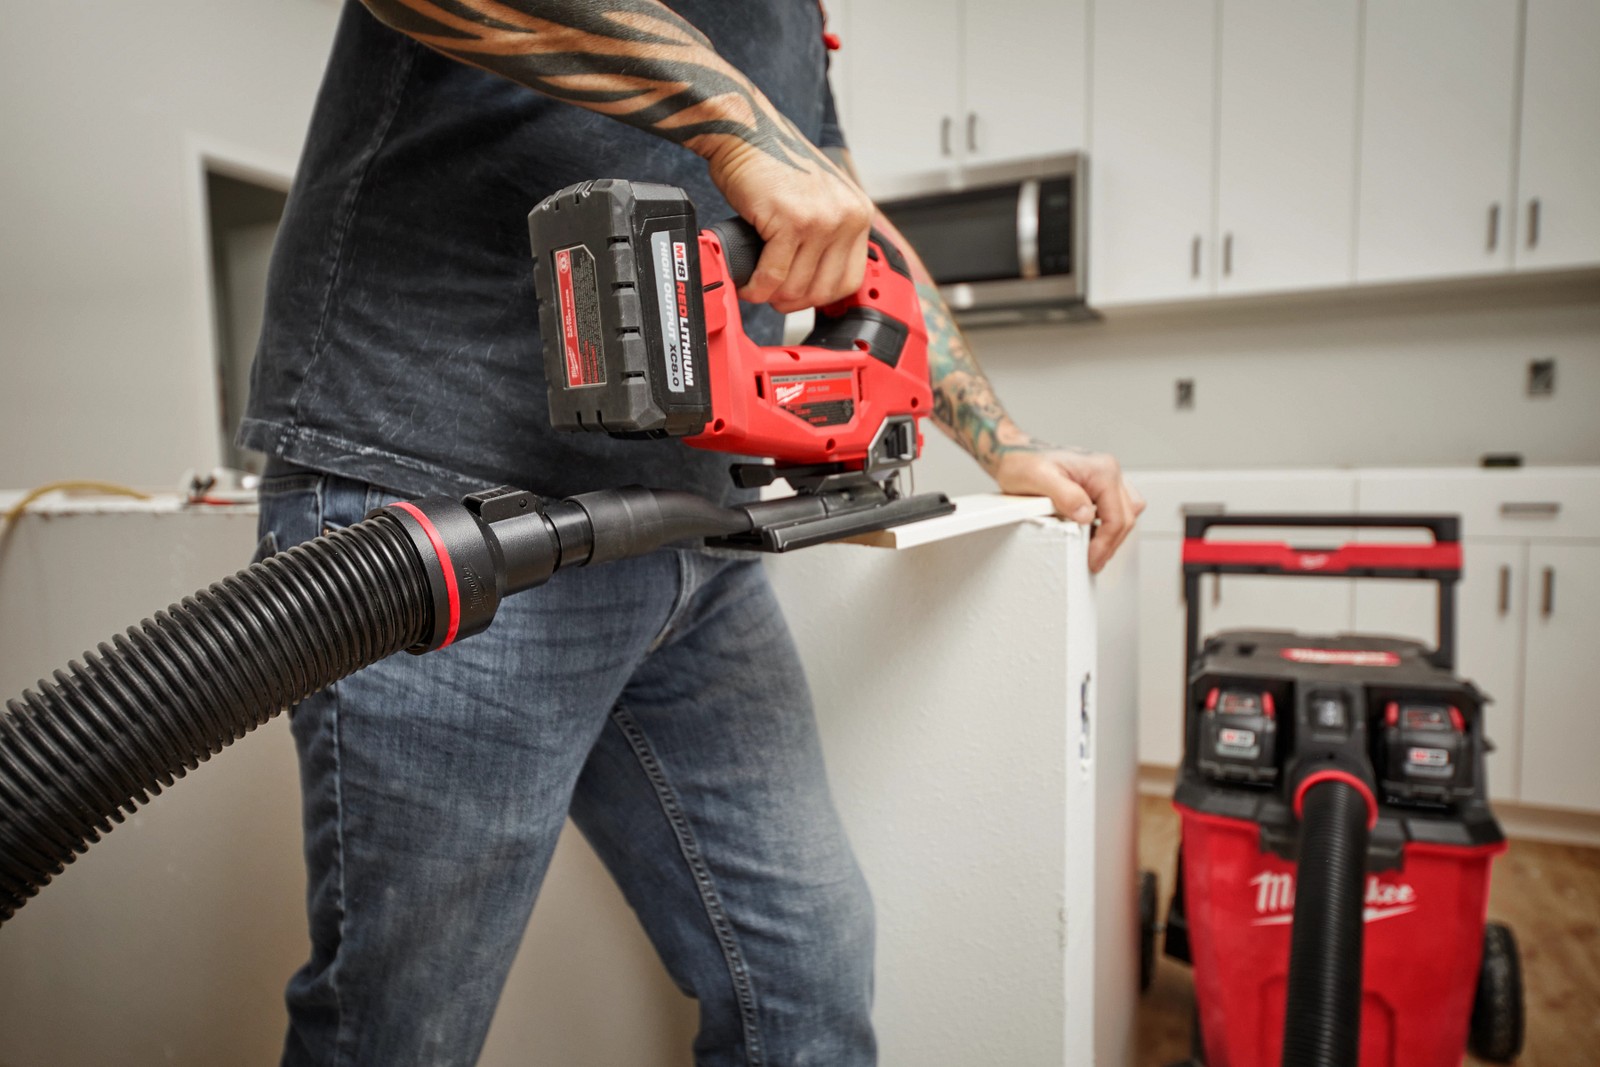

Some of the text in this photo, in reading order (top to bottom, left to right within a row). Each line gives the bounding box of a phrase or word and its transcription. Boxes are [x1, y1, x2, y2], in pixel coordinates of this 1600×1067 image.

[660, 241, 680, 387] HIGH OUTPUT XC8.0
[674, 244, 695, 387] M18 REDLITHIUM
